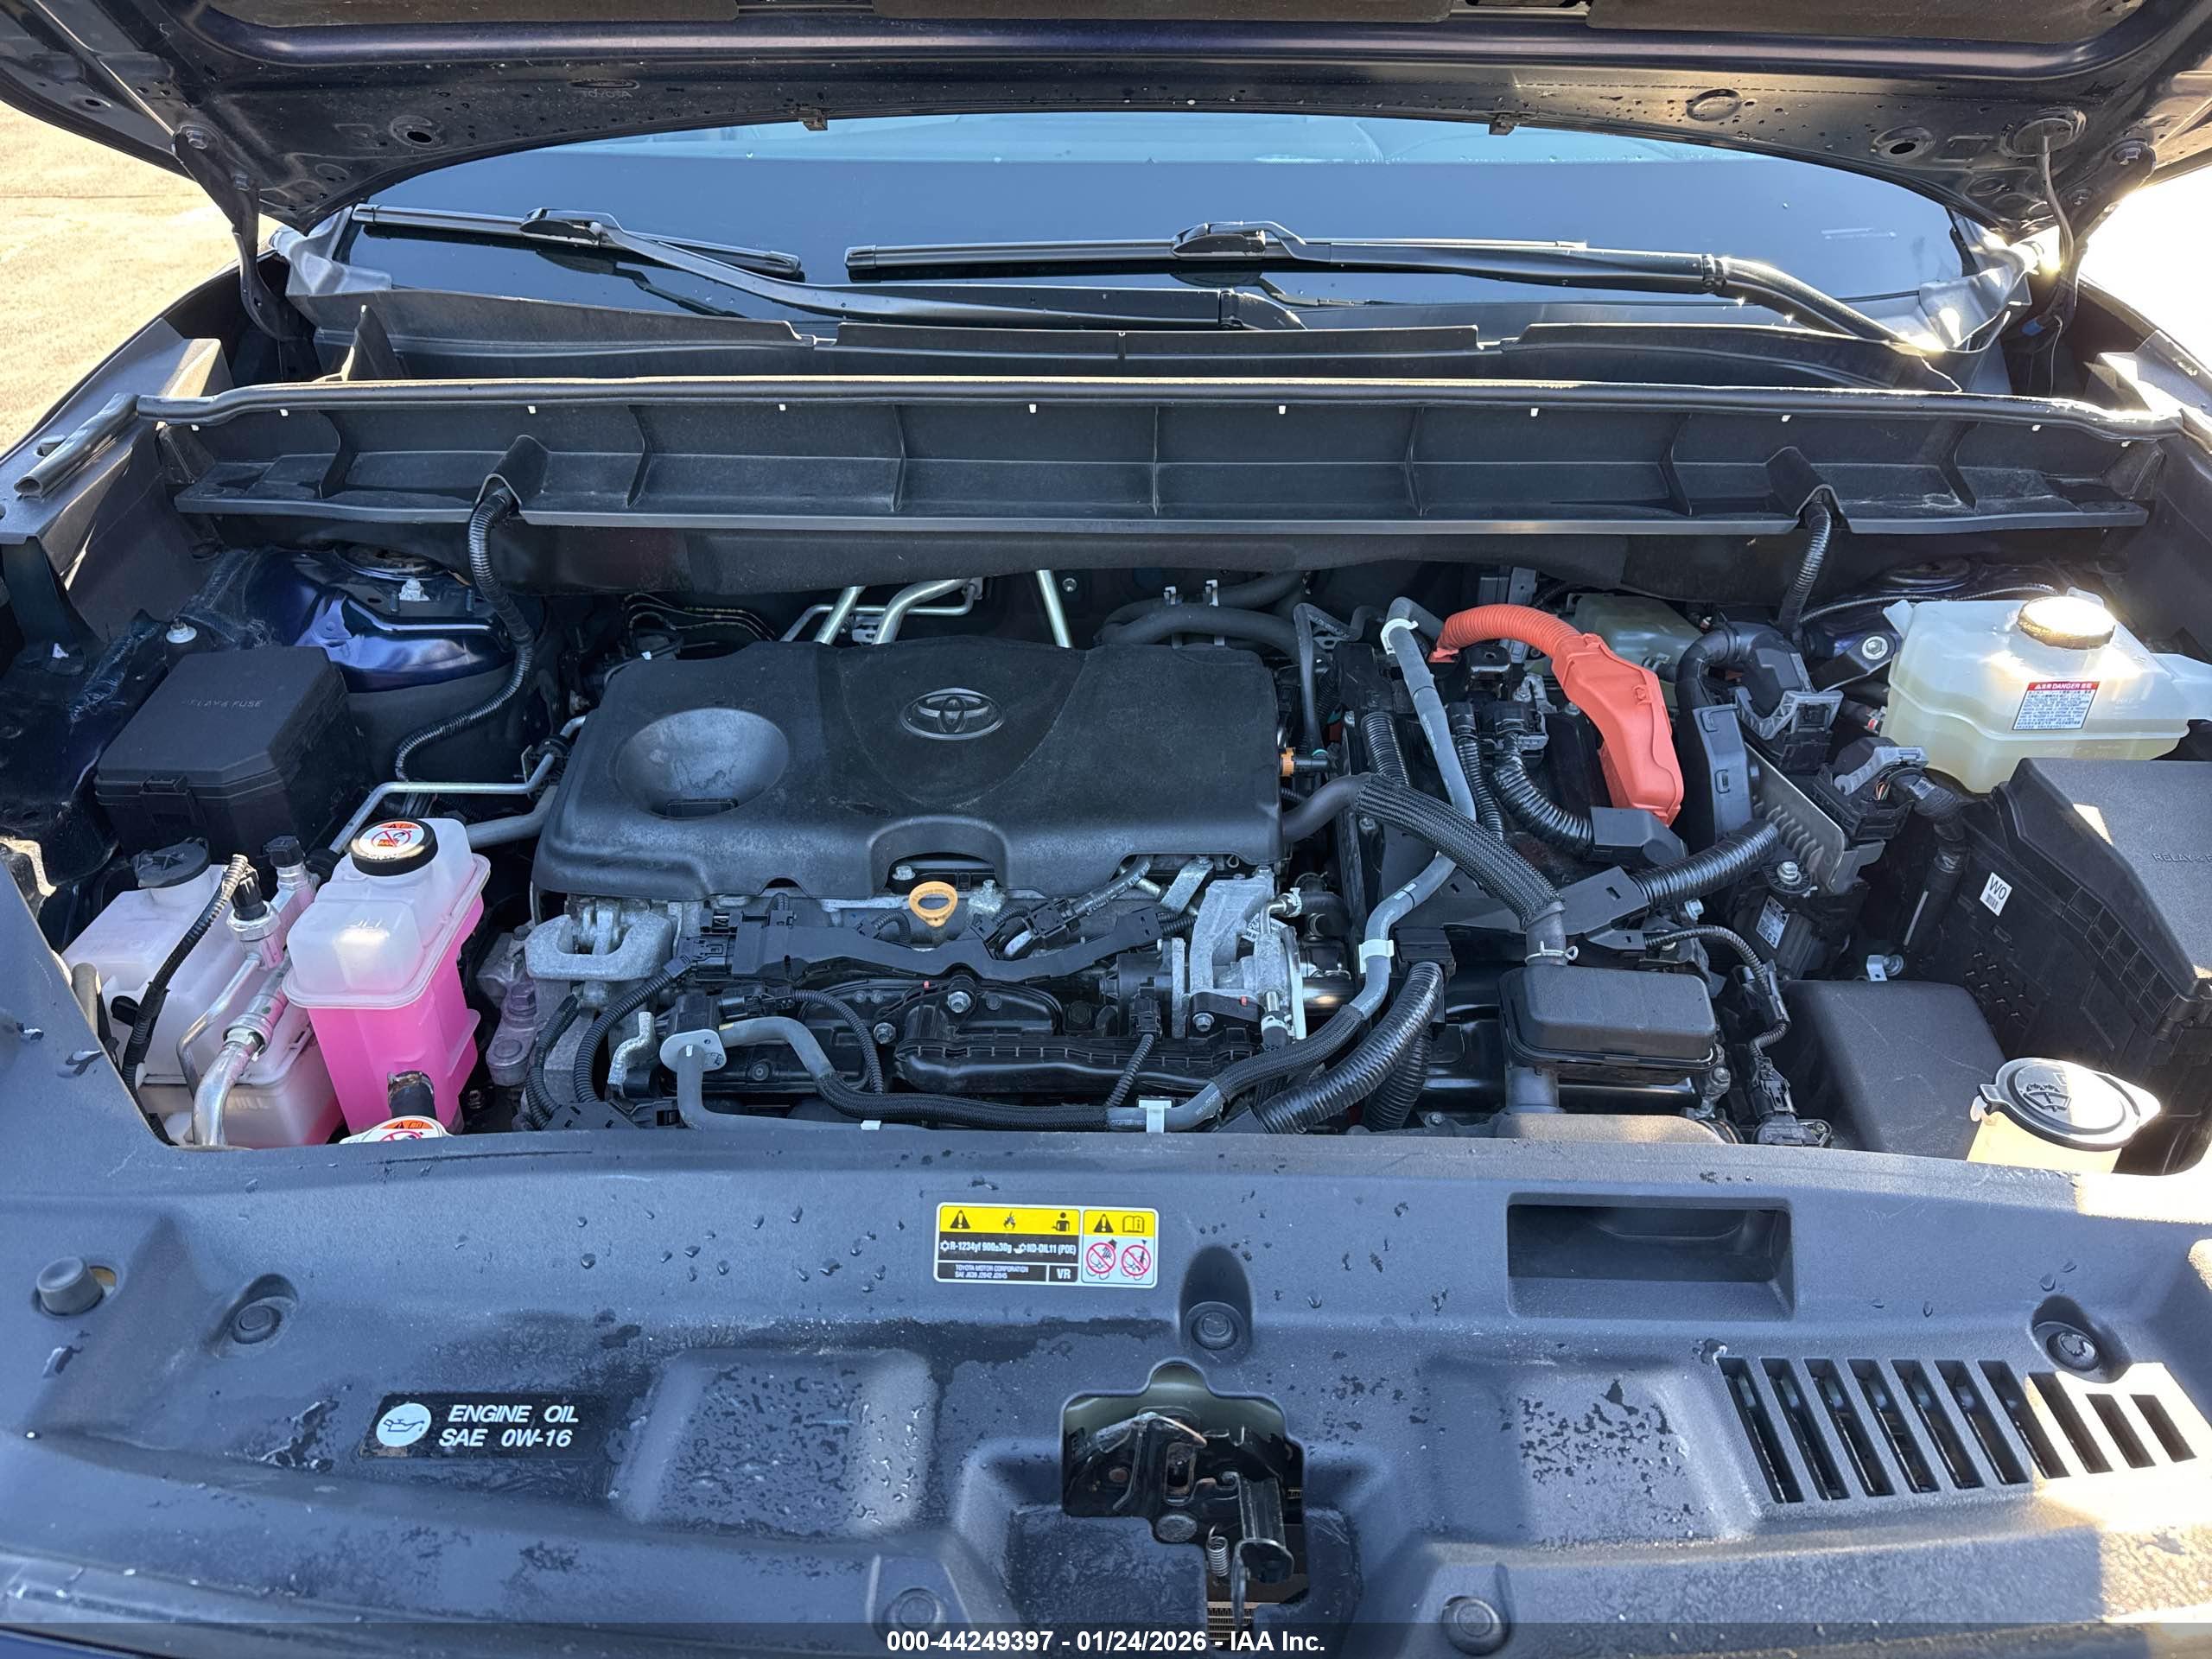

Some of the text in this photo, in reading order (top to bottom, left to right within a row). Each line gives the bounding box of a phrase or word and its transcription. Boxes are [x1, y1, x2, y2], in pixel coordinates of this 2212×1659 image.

[2151, 853, 2193, 863] RELAY
[950, 1242, 982, 1253] R-1234yf
[1057, 1244, 1077, 1256] (POE)
[1056, 1268, 1071, 1280] VR
[448, 1404, 579, 1423] ENGINE OIL
[438, 1427, 572, 1447] SAE 0W-16
